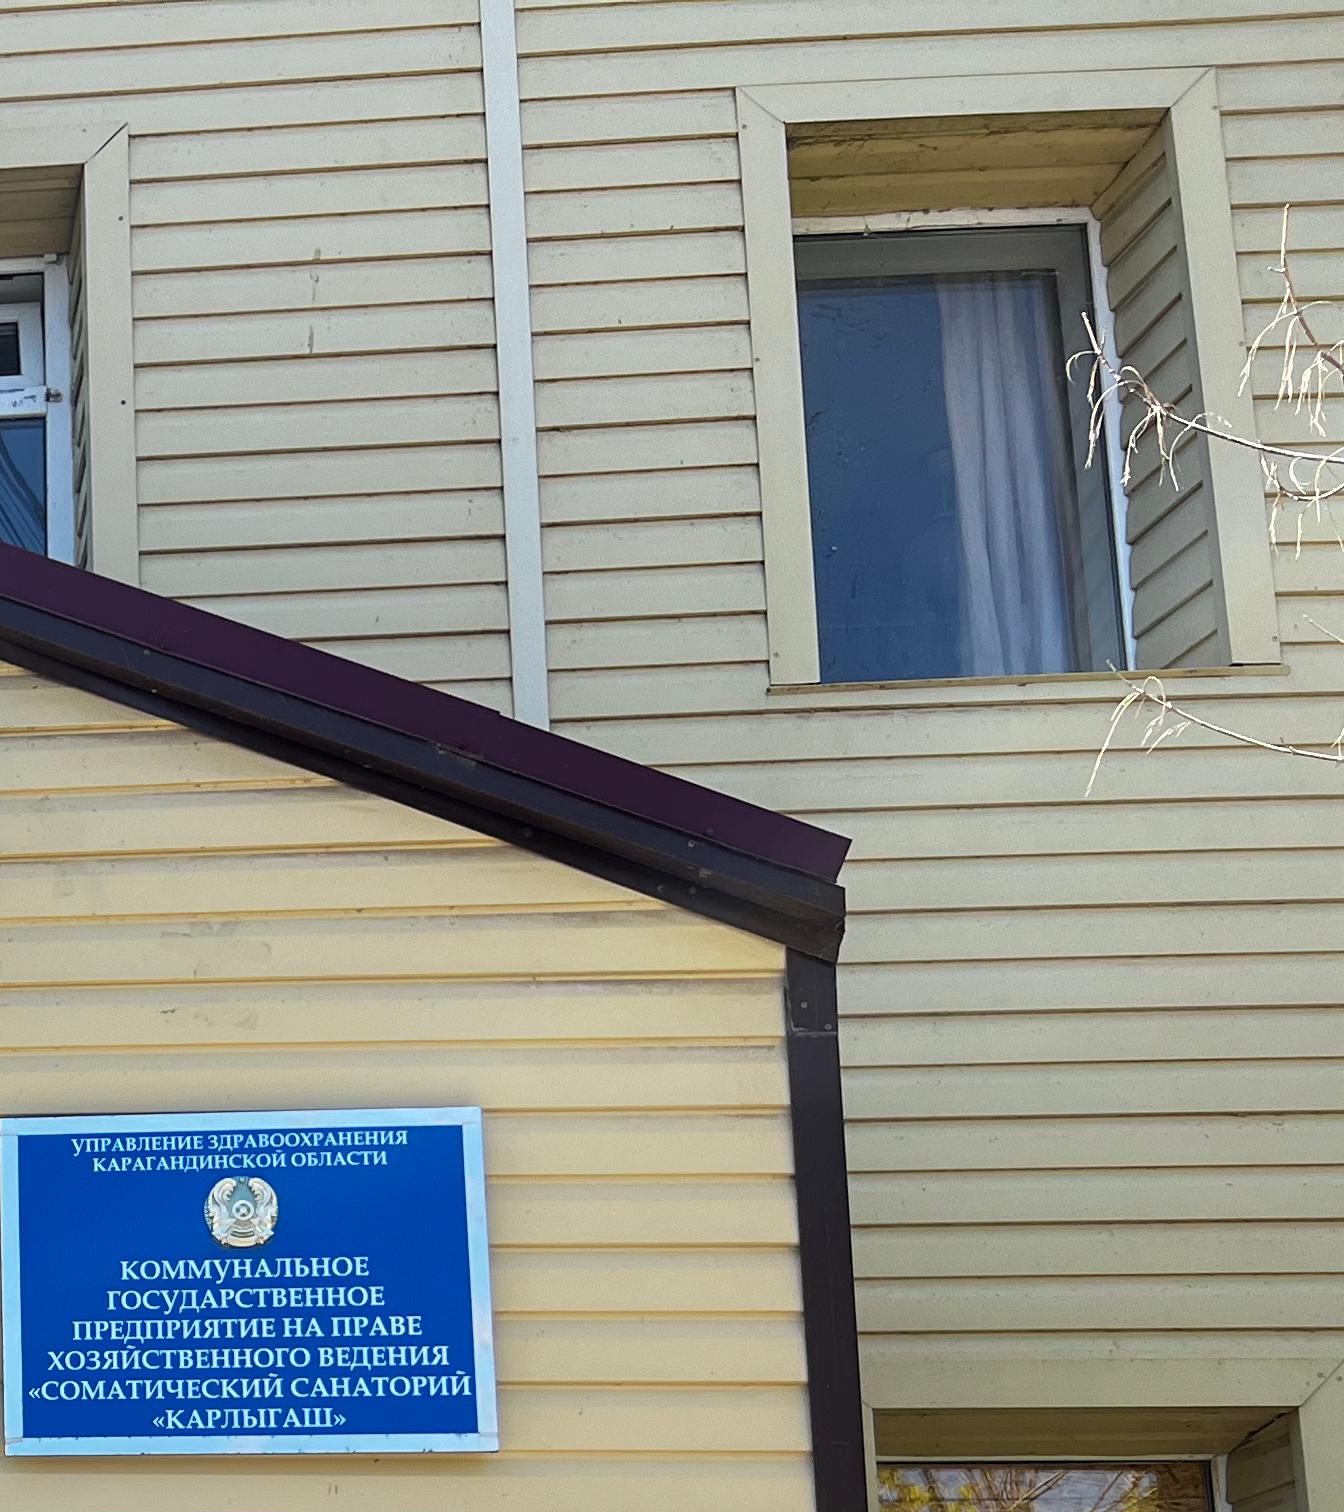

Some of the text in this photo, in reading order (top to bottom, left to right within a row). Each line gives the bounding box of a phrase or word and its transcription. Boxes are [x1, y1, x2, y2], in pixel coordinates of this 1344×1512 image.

[71, 1131, 407, 1156] УПРАВЛЕНИЕ ЗДРАВООХРАНЕНИЯ
[93, 1150, 387, 1172] КАРАГАНДИНСКОЙ ОБЛАСТИ
[121, 1257, 369, 1284] КОММУНАЛЬНОЕ
[107, 1286, 384, 1315] ГОСУДАРСТВЕННОЕ
[73, 1316, 422, 1344] ПРЕДПРИЯТИЕ НА ПРАВЕ
[48, 1345, 449, 1371] ХОЗЯЙСТВЕННОГО ВЕДЕНИЯ
[29, 1371, 471, 1400] «СОМАТИЧЕСКИЙ САНАТОРИЙ
[153, 1408, 346, 1429] «КАРЛЫГАШ»
